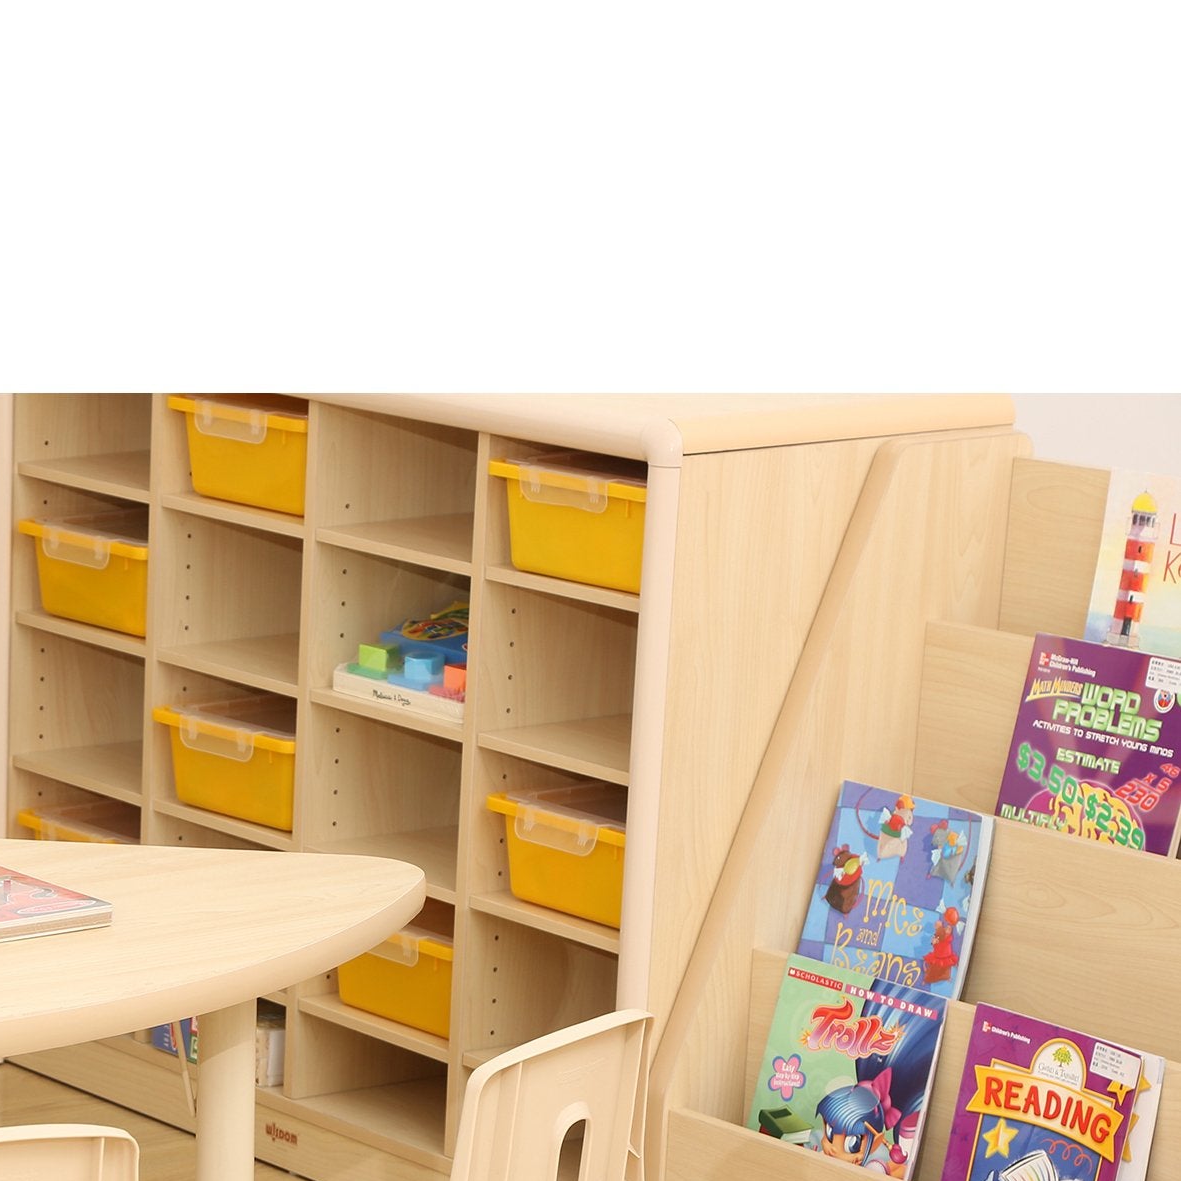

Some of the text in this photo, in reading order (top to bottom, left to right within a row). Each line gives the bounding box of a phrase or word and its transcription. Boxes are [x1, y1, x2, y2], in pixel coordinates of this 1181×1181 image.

[1049, 659, 1071, 671] Children's
[1071, 664, 1097, 678] Publishing
[1081, 682, 1141, 715] WORD
[1052, 698, 1163, 743] PROBLEMS
[1032, 719, 1174, 758] ACTIVITIES TO STRETCH YOUNG MINDS
[1056, 747, 1121, 775] ESTIMATE
[1159, 763, 1181, 779] 46
[1115, 780, 1160, 813] 230
[1155, 777, 1173, 795] 5
[1000, 803, 1068, 831] MULTIPLY
[856, 922, 883, 947] and
[795, 970, 843, 990] SCHOLASTIC
[849, 986, 934, 1018] HOW TO DRAW
[808, 997, 896, 1058] Trollz
[991, 1026, 1031, 1045] Children's Publishing
[983, 1076, 1113, 1144] READING
